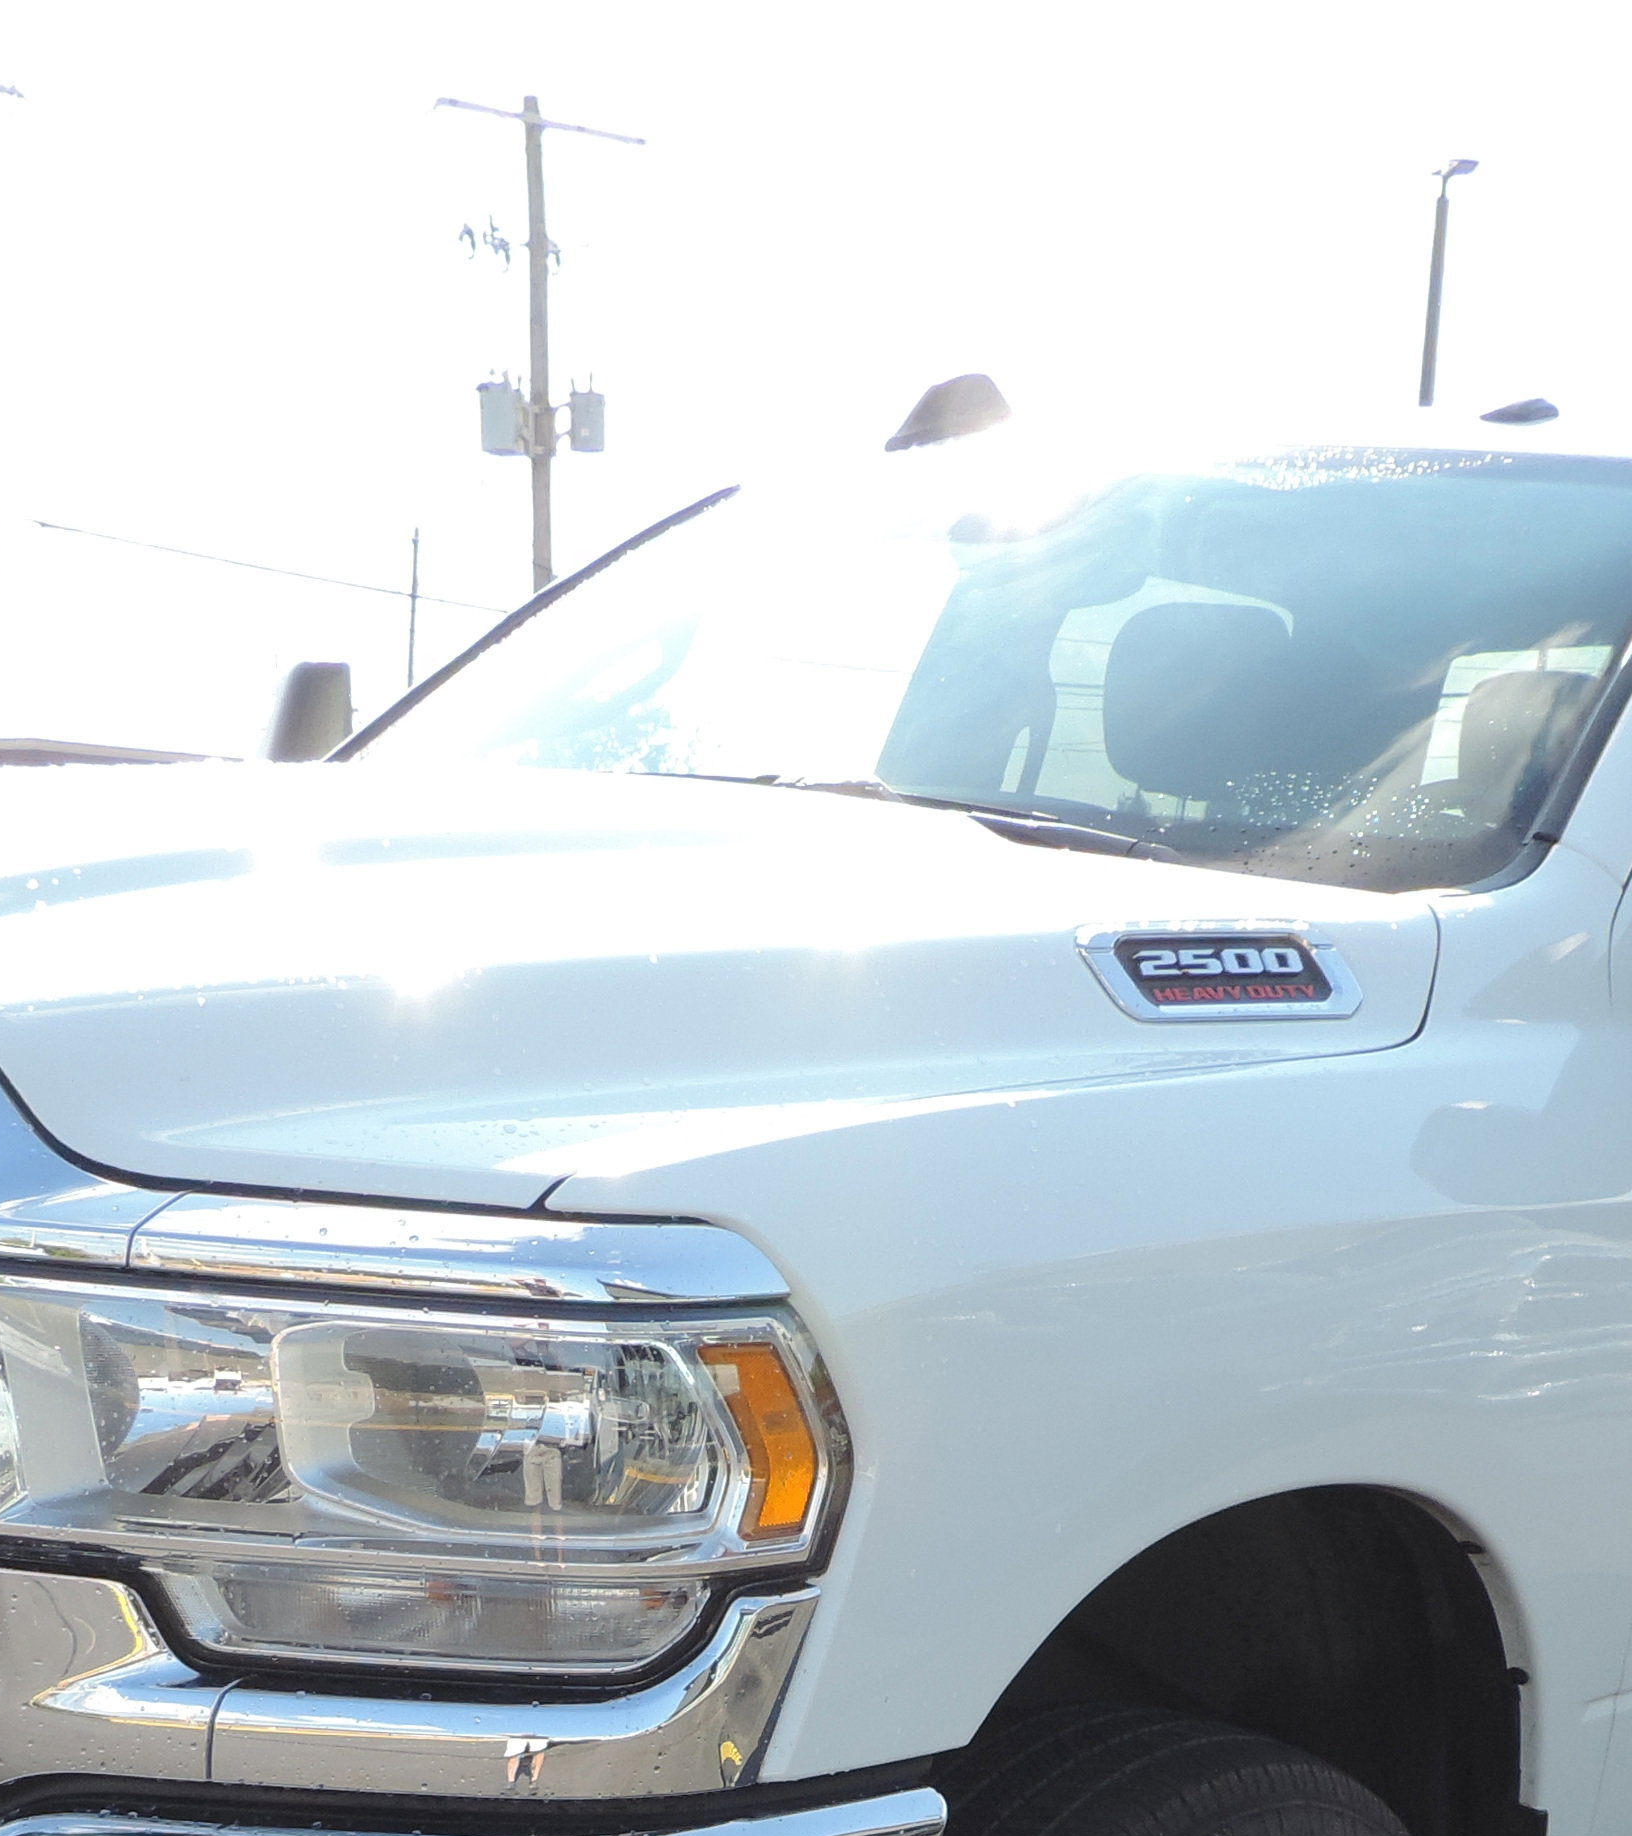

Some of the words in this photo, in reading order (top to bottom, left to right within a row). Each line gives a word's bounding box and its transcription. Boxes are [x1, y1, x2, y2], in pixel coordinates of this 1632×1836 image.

[1132, 947, 1305, 977] 2500
[1152, 984, 1242, 1003] HEAVY
[1245, 983, 1317, 1000] DUTY
